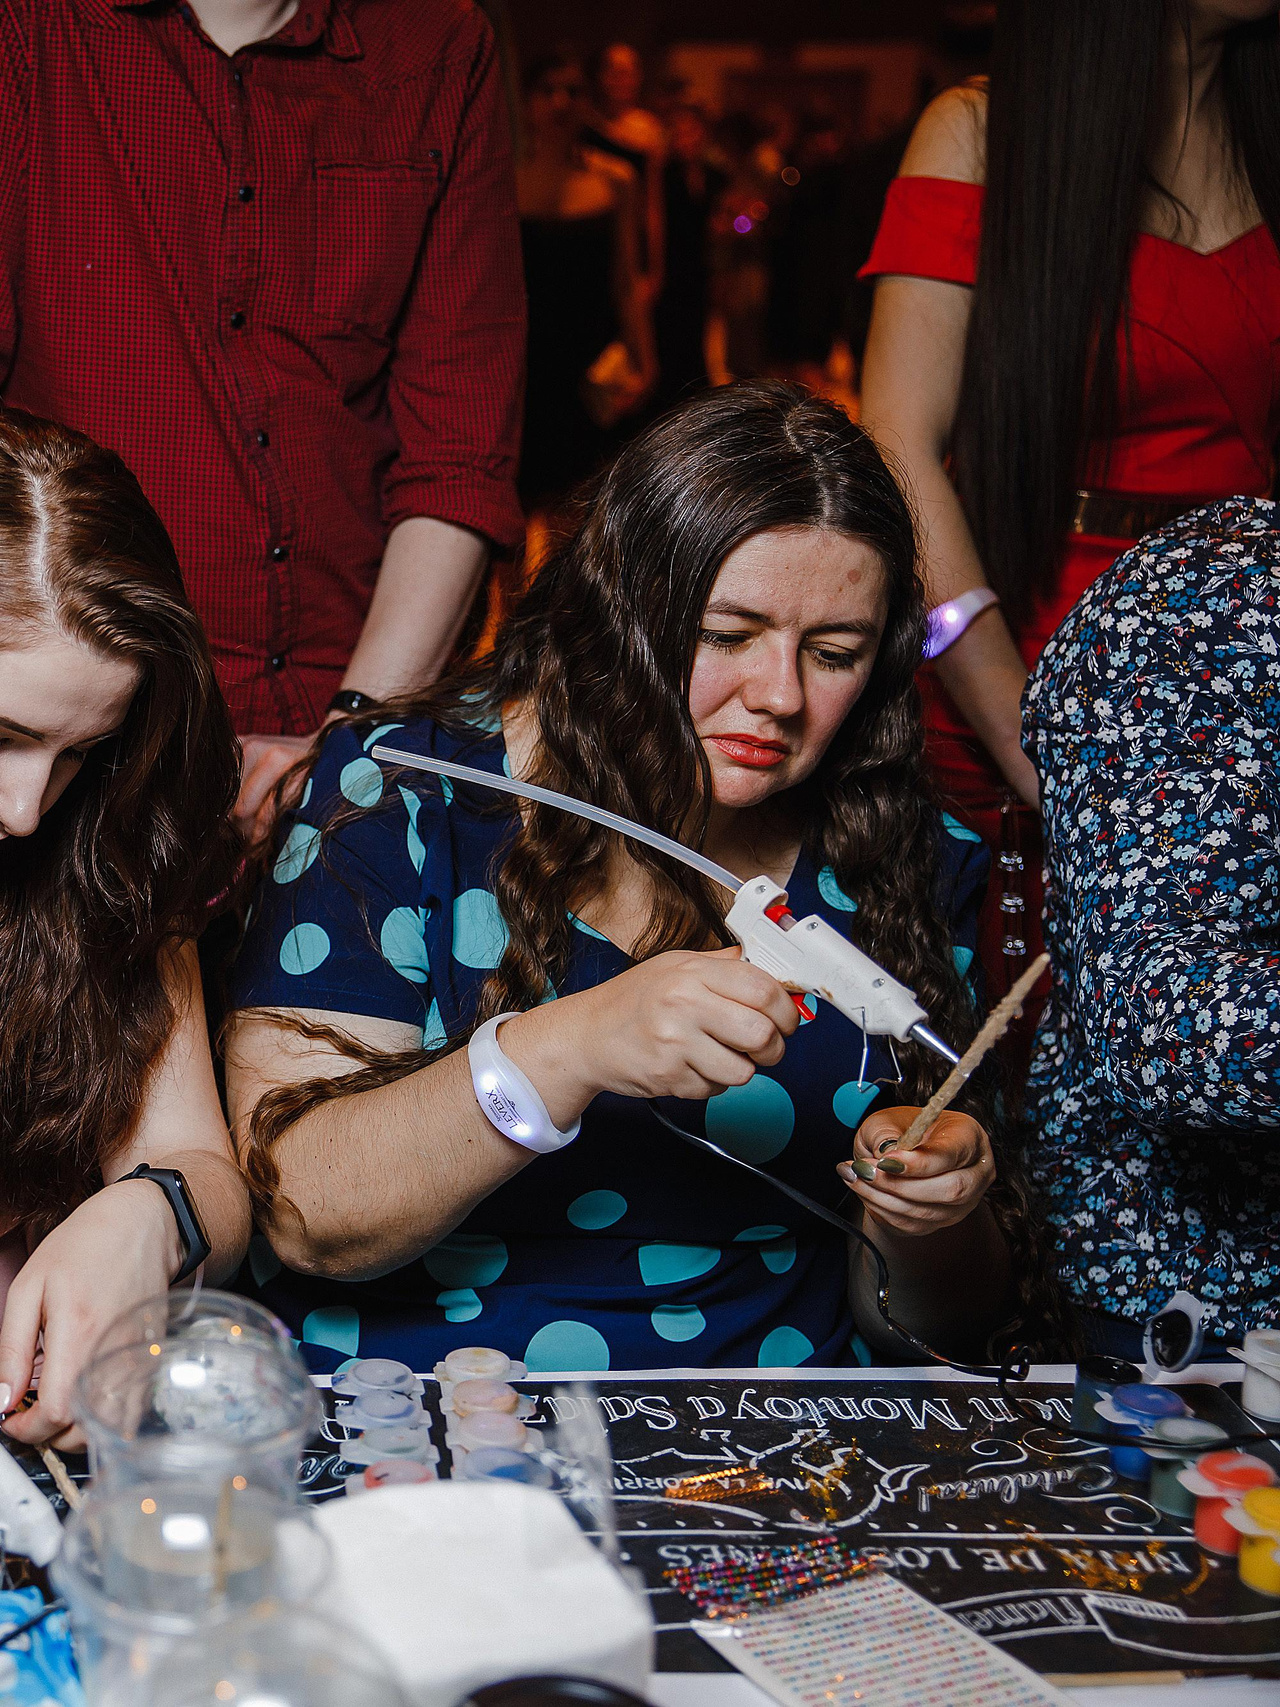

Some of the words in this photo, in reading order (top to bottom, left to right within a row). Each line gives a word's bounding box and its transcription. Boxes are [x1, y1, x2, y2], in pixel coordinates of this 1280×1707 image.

[486, 1090, 517, 1129] LEVERX
[687, 1389, 968, 1431] Montoya
[607, 1476, 702, 1491] CORRI
[860, 1546, 963, 1571] LOS
[966, 1547, 1049, 1573] DE
